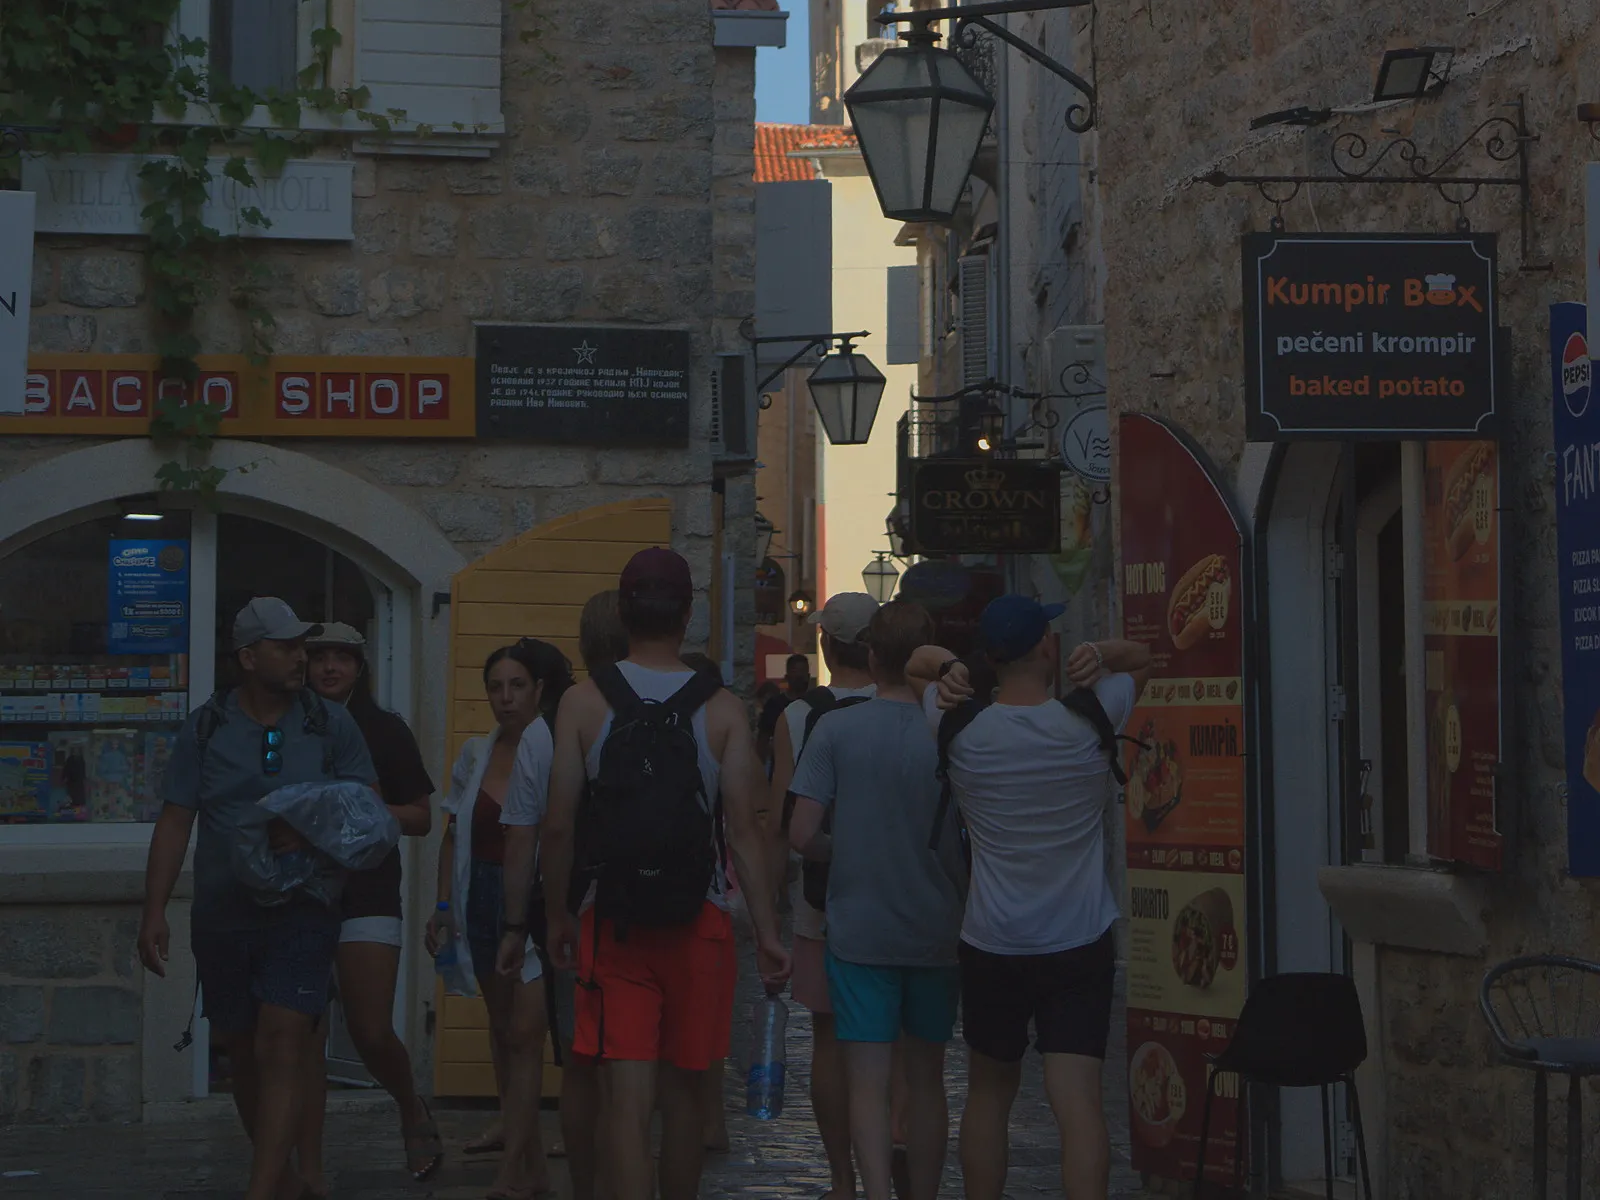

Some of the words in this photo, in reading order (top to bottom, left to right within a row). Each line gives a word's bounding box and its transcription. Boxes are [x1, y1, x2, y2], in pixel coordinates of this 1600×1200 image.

[45, 168, 139, 207] VILLA
[1266, 275, 1391, 313] Kumpir
[1276, 330, 1363, 356] pečeni
[1372, 331, 1476, 356] krompir
[1289, 374, 1370, 397] baked
[1378, 376, 1465, 399] potato
[1563, 365, 1590, 385] PEPSI
[280, 374, 444, 416] SHOP
[921, 489, 1046, 510] CROWN
[1572, 550, 1591, 567] PIZZA
[1125, 563, 1144, 595] HOT
[1146, 561, 1166, 595] DOG
[1573, 578, 1592, 595] PIZZA
[1575, 635, 1594, 651] PIZZA
[1131, 886, 1169, 920] BURRITO
